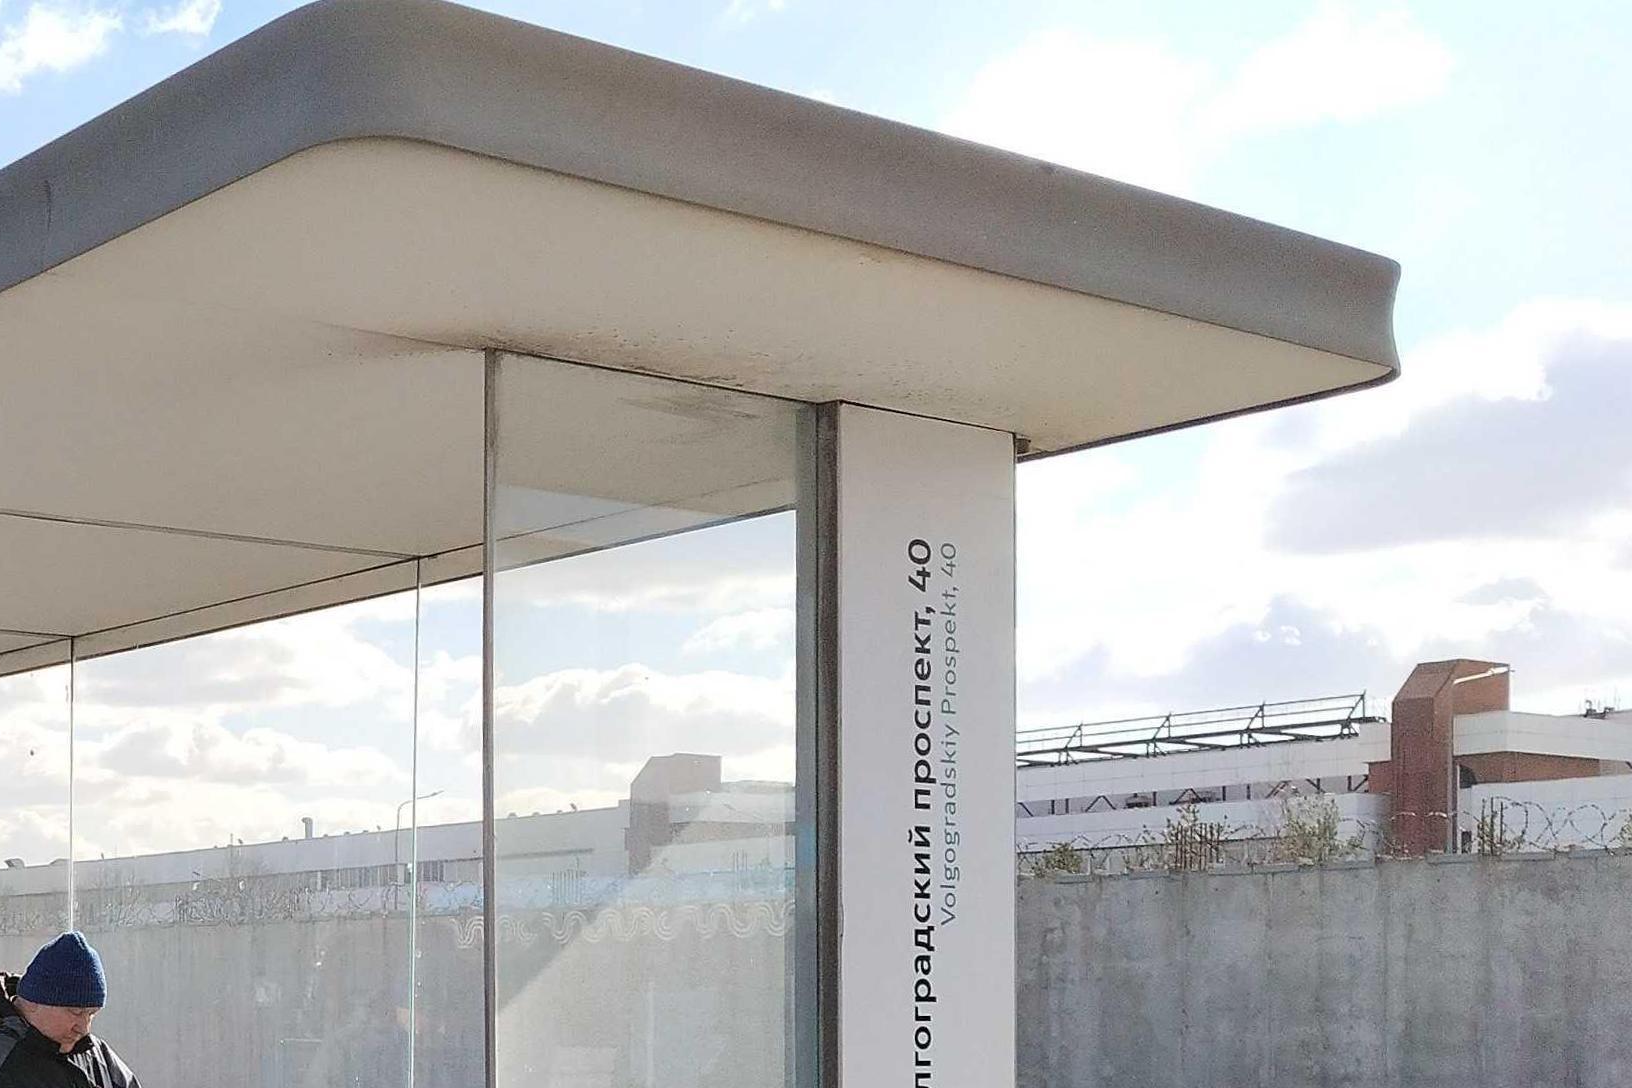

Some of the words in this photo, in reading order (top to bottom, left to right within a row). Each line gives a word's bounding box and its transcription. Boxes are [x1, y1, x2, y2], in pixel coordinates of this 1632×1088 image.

[908, 538, 933, 592] 40
[940, 542, 957, 577] 40
[914, 605, 936, 811] проспект,
[940, 586, 960, 715] Prospekt,
[940, 723, 960, 926] Volgogradskiy
